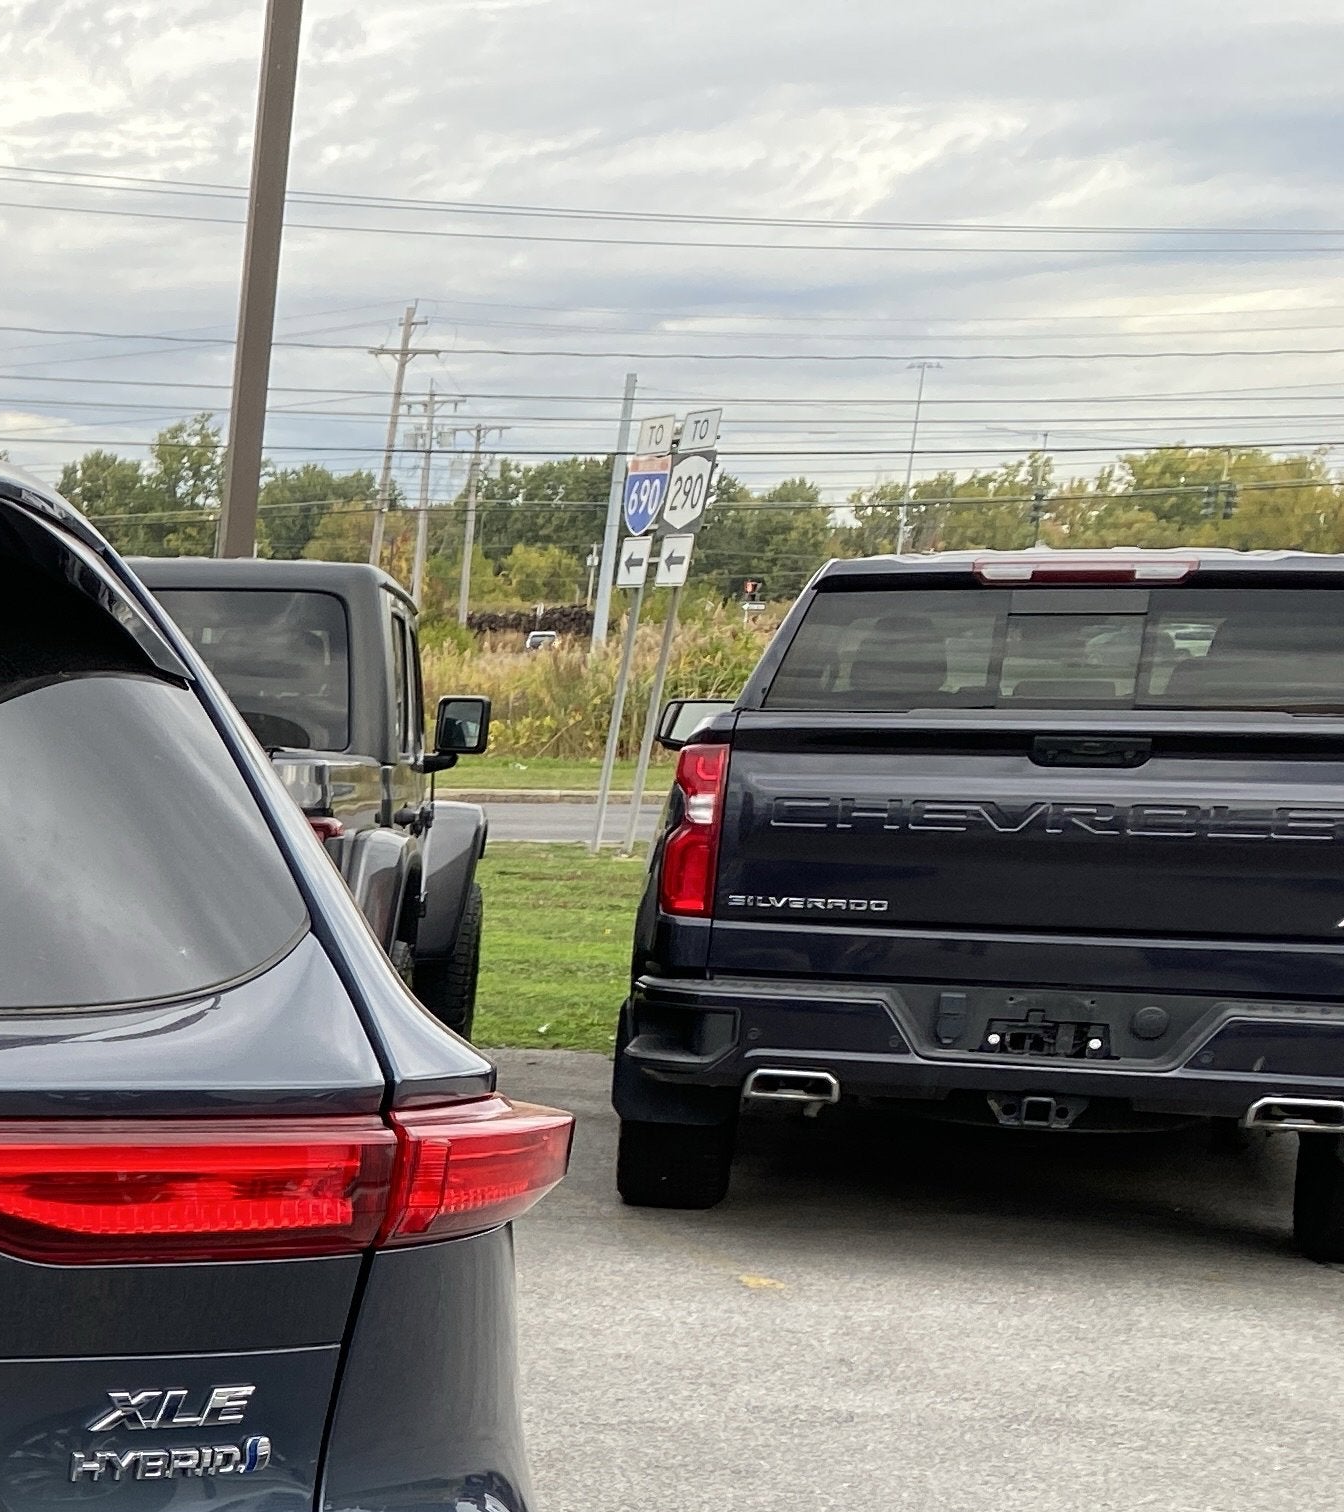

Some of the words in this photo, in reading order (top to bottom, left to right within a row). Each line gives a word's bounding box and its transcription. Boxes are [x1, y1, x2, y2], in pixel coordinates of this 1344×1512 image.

[648, 424, 664, 447] TO
[693, 419, 709, 441] TO
[628, 478, 661, 516] 690
[669, 473, 703, 511] 290
[770, 798, 1344, 841] CHEVROLE
[728, 894, 889, 911] SILVERADO
[85, 1383, 257, 1432] XLE
[69, 1444, 244, 1483] HYBRID
